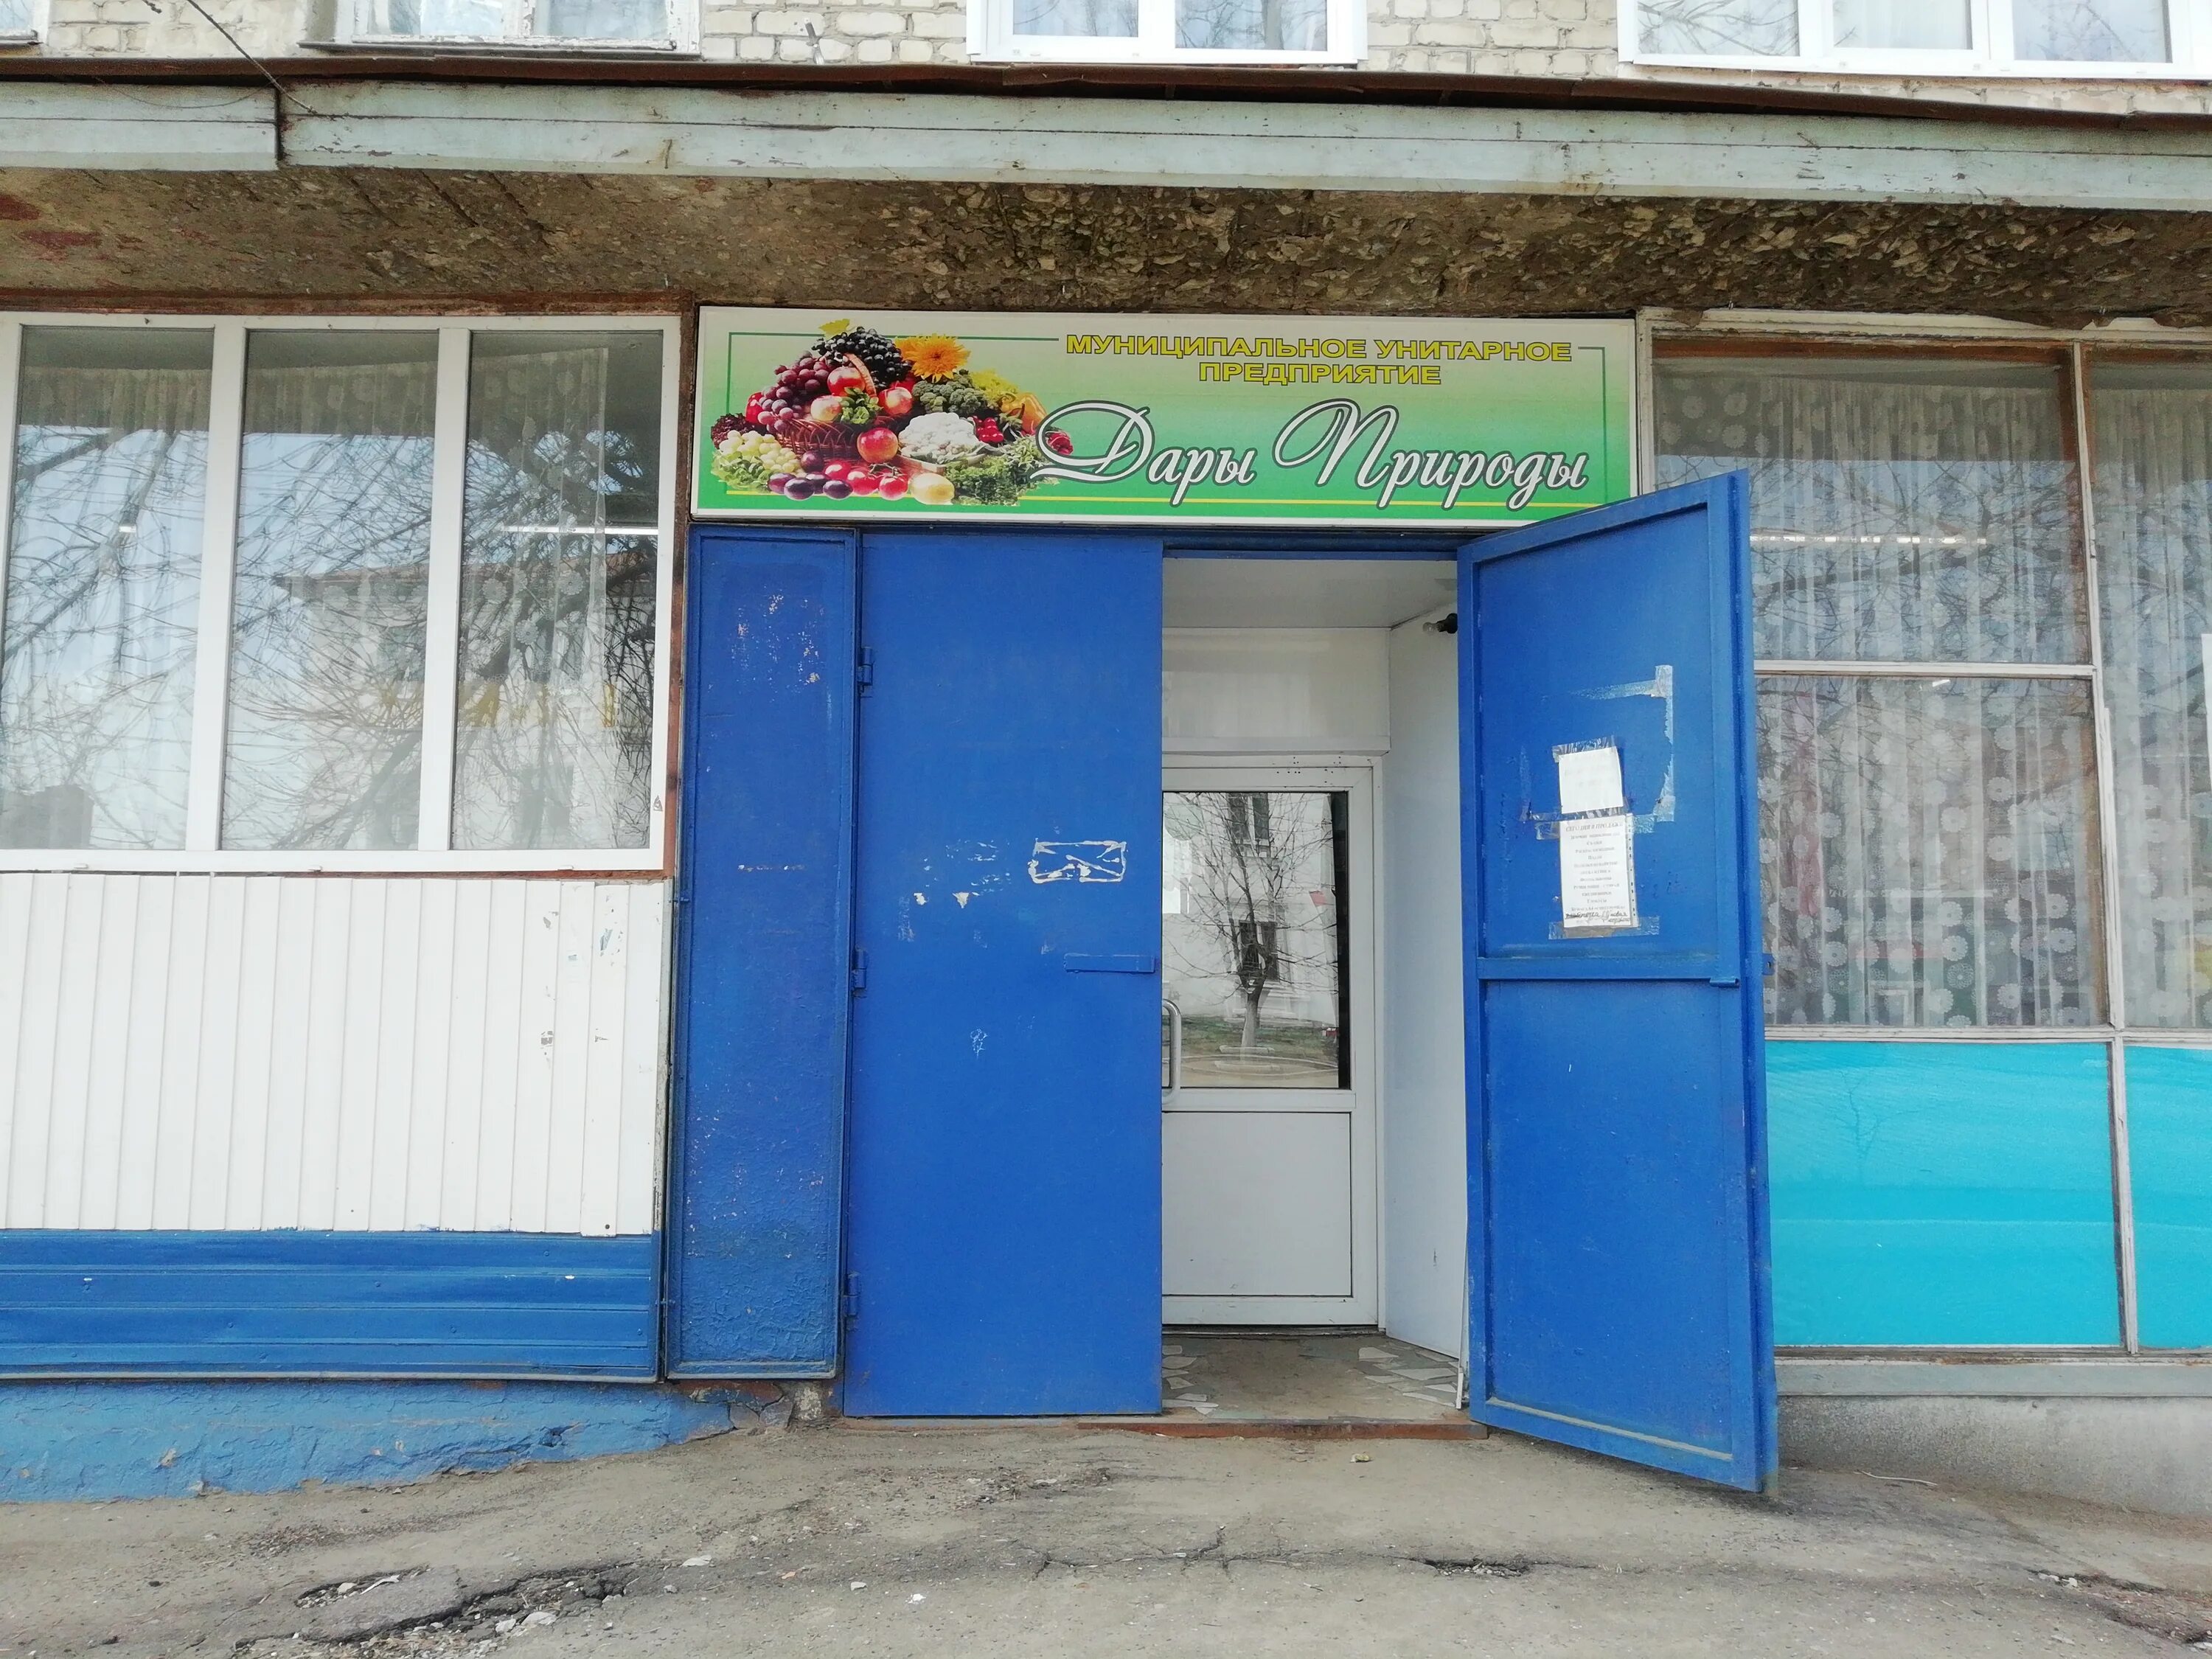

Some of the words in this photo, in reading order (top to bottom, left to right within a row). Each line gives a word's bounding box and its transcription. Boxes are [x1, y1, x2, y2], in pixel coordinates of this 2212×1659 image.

[1066, 334, 1367, 358] МУНИЦИПАЛЬНОЕ
[1374, 339, 1572, 362] УНИТАРНОЕ
[1199, 362, 1441, 386] ПРЕДПРИЯТИЕ
[1029, 400, 1258, 507] Дары
[1272, 397, 1589, 512] Природы
